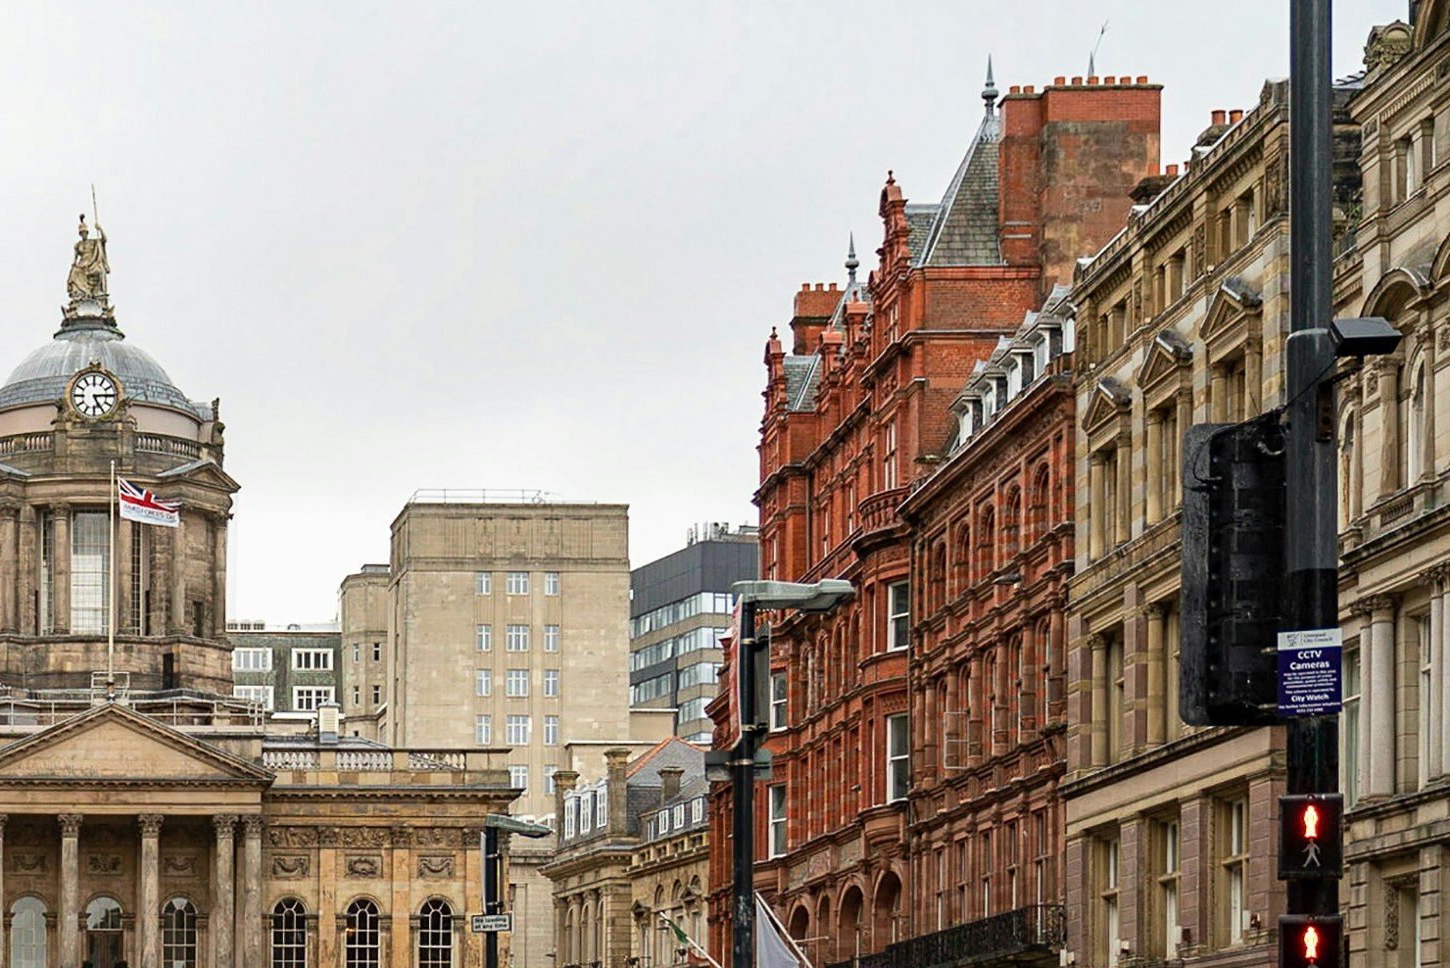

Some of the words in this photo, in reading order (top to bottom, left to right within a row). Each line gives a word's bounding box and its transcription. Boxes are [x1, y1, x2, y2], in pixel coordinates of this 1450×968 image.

[1297, 650, 1322, 660] CCTV
[1289, 661, 1330, 670] Cameras
[1306, 693, 1330, 701] Watch
